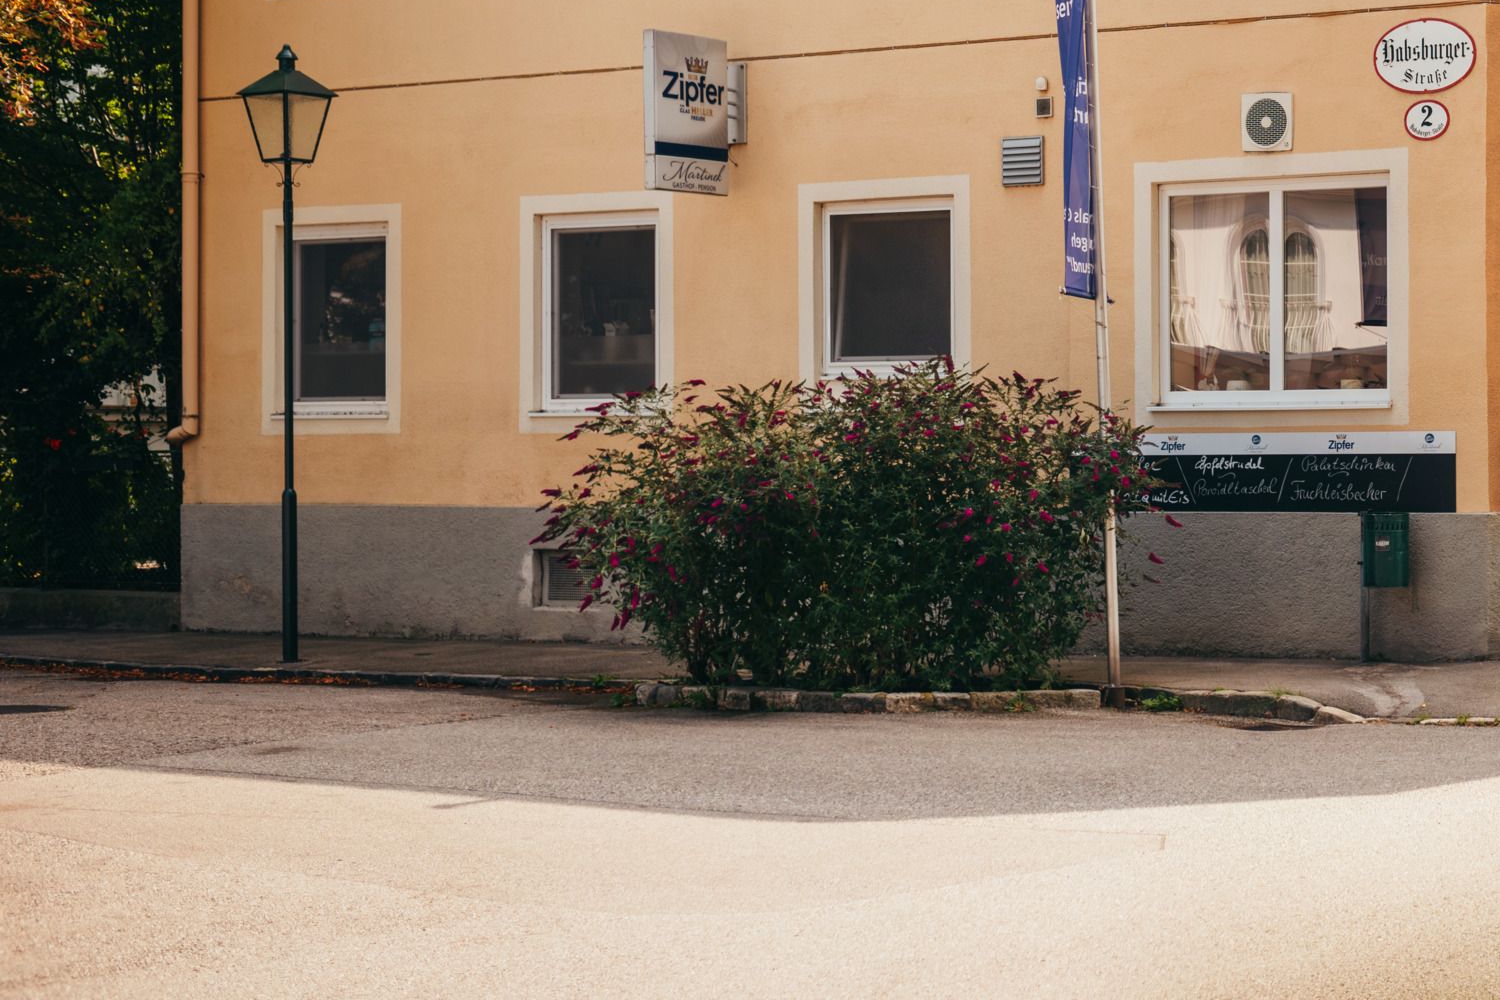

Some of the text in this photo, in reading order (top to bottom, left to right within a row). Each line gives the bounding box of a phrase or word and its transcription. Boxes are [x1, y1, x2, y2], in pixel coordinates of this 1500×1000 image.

[1402, 68, 1447, 86] Straße
[662, 70, 725, 107] Zipfer
[1421, 105, 1433, 127] 2
[662, 160, 726, 183] Martinek
[1161, 441, 1186, 453] Zipfer
[1328, 440, 1354, 452] Zipfer
